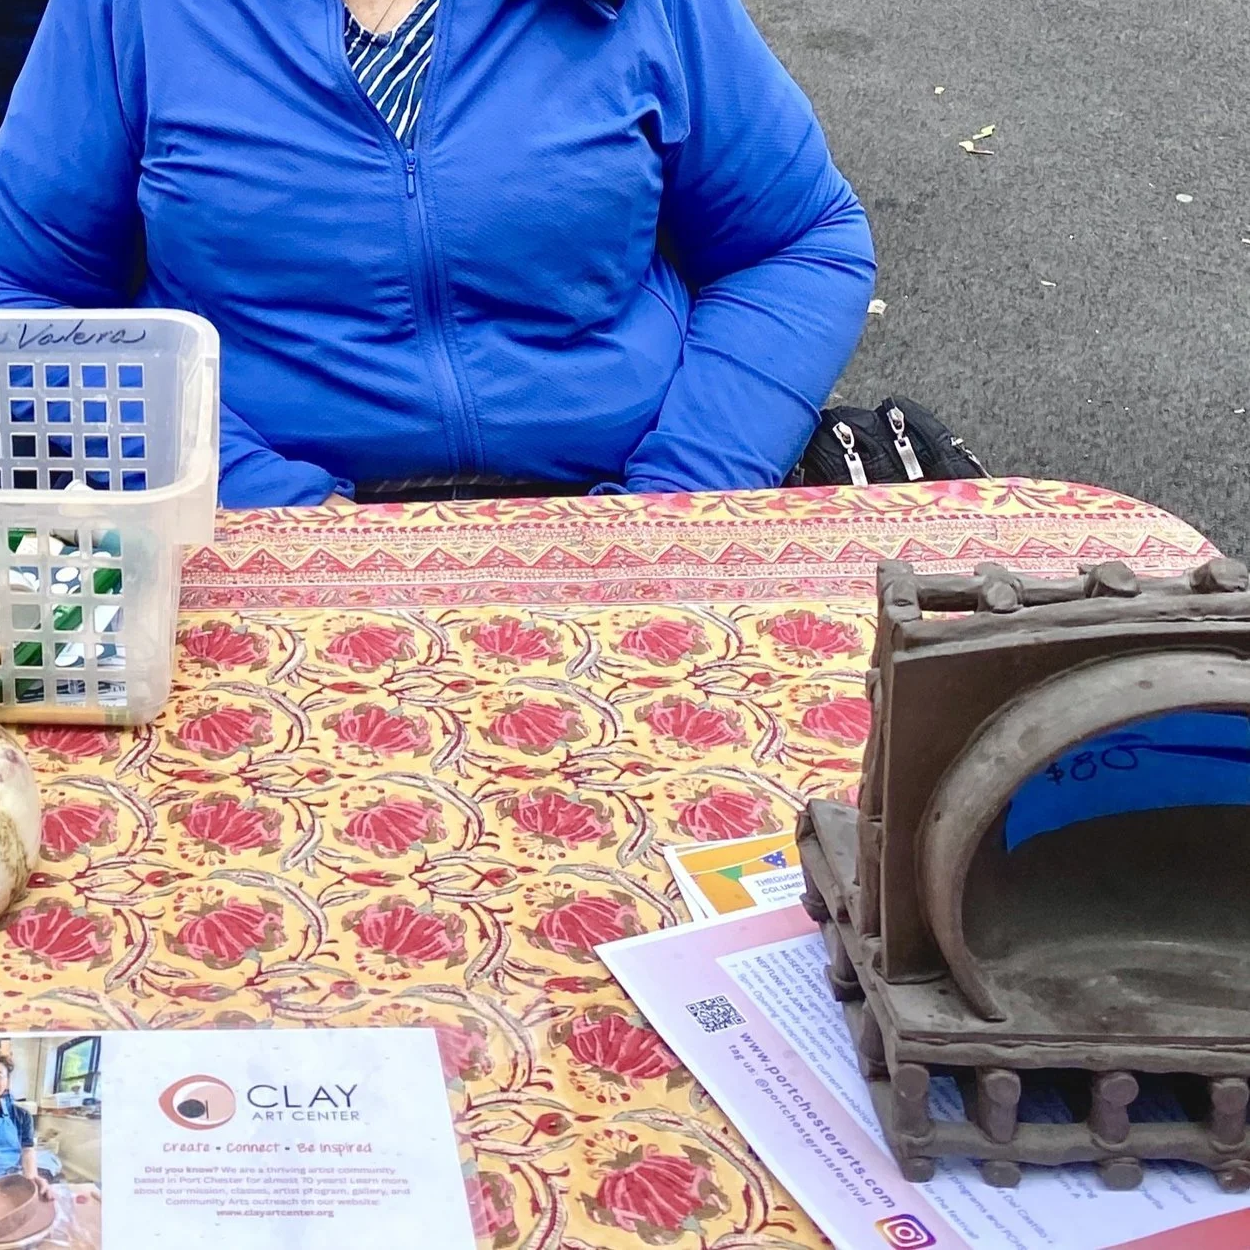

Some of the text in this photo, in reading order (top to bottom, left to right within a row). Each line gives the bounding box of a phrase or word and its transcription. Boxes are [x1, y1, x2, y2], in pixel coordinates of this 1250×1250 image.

[777, 949, 805, 974] MUSEO
[752, 956, 786, 988] NEPTUNE
[780, 987, 793, 996] IN
[728, 1043, 745, 1062] tag
[247, 1083, 359, 1109] CLAY
[251, 1110, 361, 1122] ART CENTER
[739, 1031, 896, 1208] www.portchesterarts.com
[163, 1142, 210, 1154] Create
[226, 1142, 280, 1154] Connect
[296, 1142, 316, 1154] Be
[144, 1165, 163, 1174] Did
[164, 1166, 184, 1175] you
[186, 1165, 219, 1174] know?
[337, 1166, 397, 1176] community
[179, 1176, 201, 1184] Port
[203, 1176, 243, 1185] Chester
[165, 1197, 226, 1207] Community
